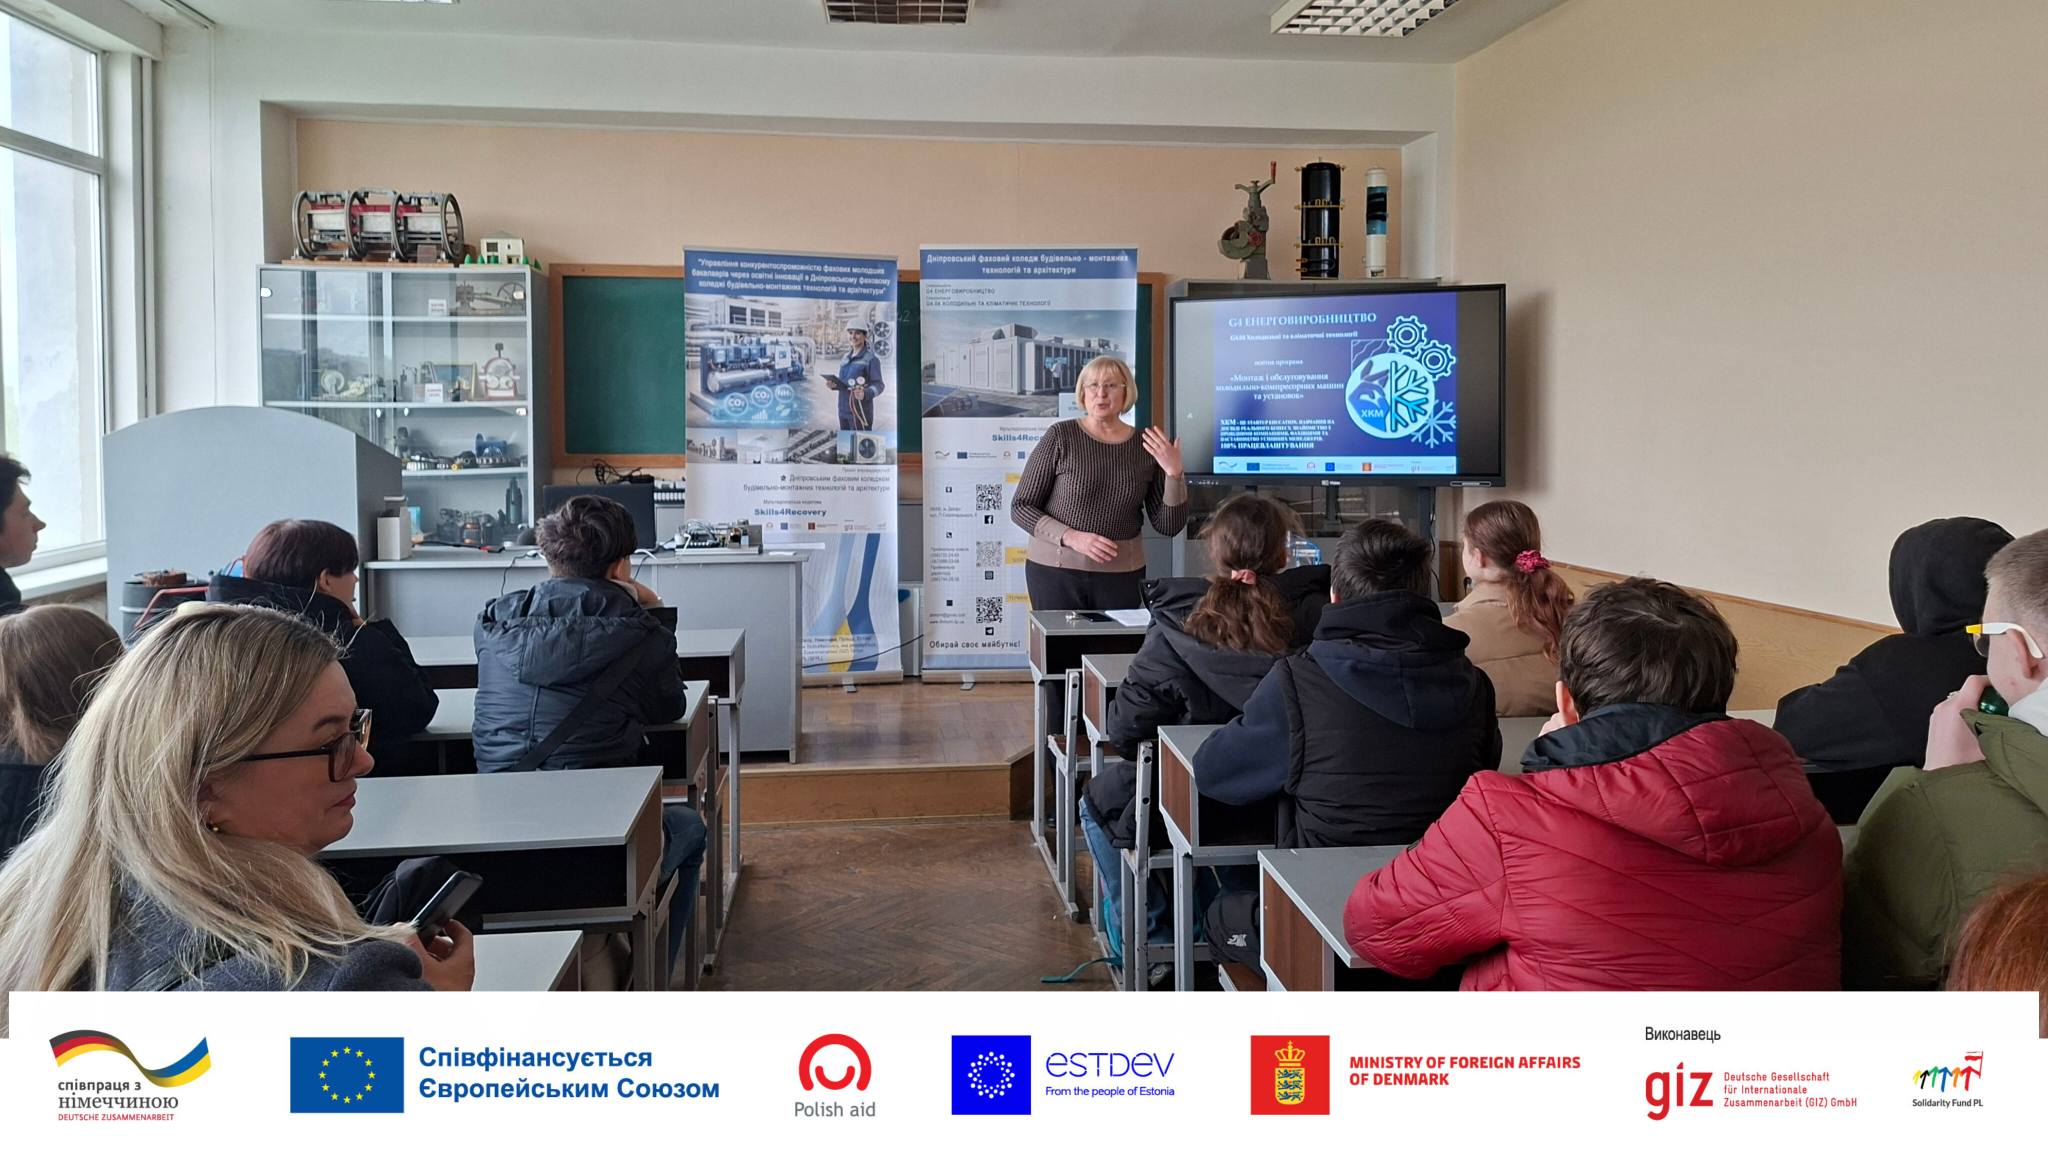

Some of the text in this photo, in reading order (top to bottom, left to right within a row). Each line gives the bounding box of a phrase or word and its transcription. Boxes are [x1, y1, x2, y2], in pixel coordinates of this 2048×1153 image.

[926, 254, 976, 264] Дніпровський
[977, 255, 1010, 264] фаховий
[1012, 255, 1039, 264] коледж
[1040, 254, 1082, 264] будівельно
[982, 266, 1021, 274] технологій
[1033, 266, 1077, 275] архітектури
[1245, 312, 1377, 327] ЕНЕРГОВИРОБНИЦТВО
[754, 508, 827, 517] Skills4Recovery
[929, 640, 959, 649] Обирай
[981, 640, 1021, 651] майбутнє!
